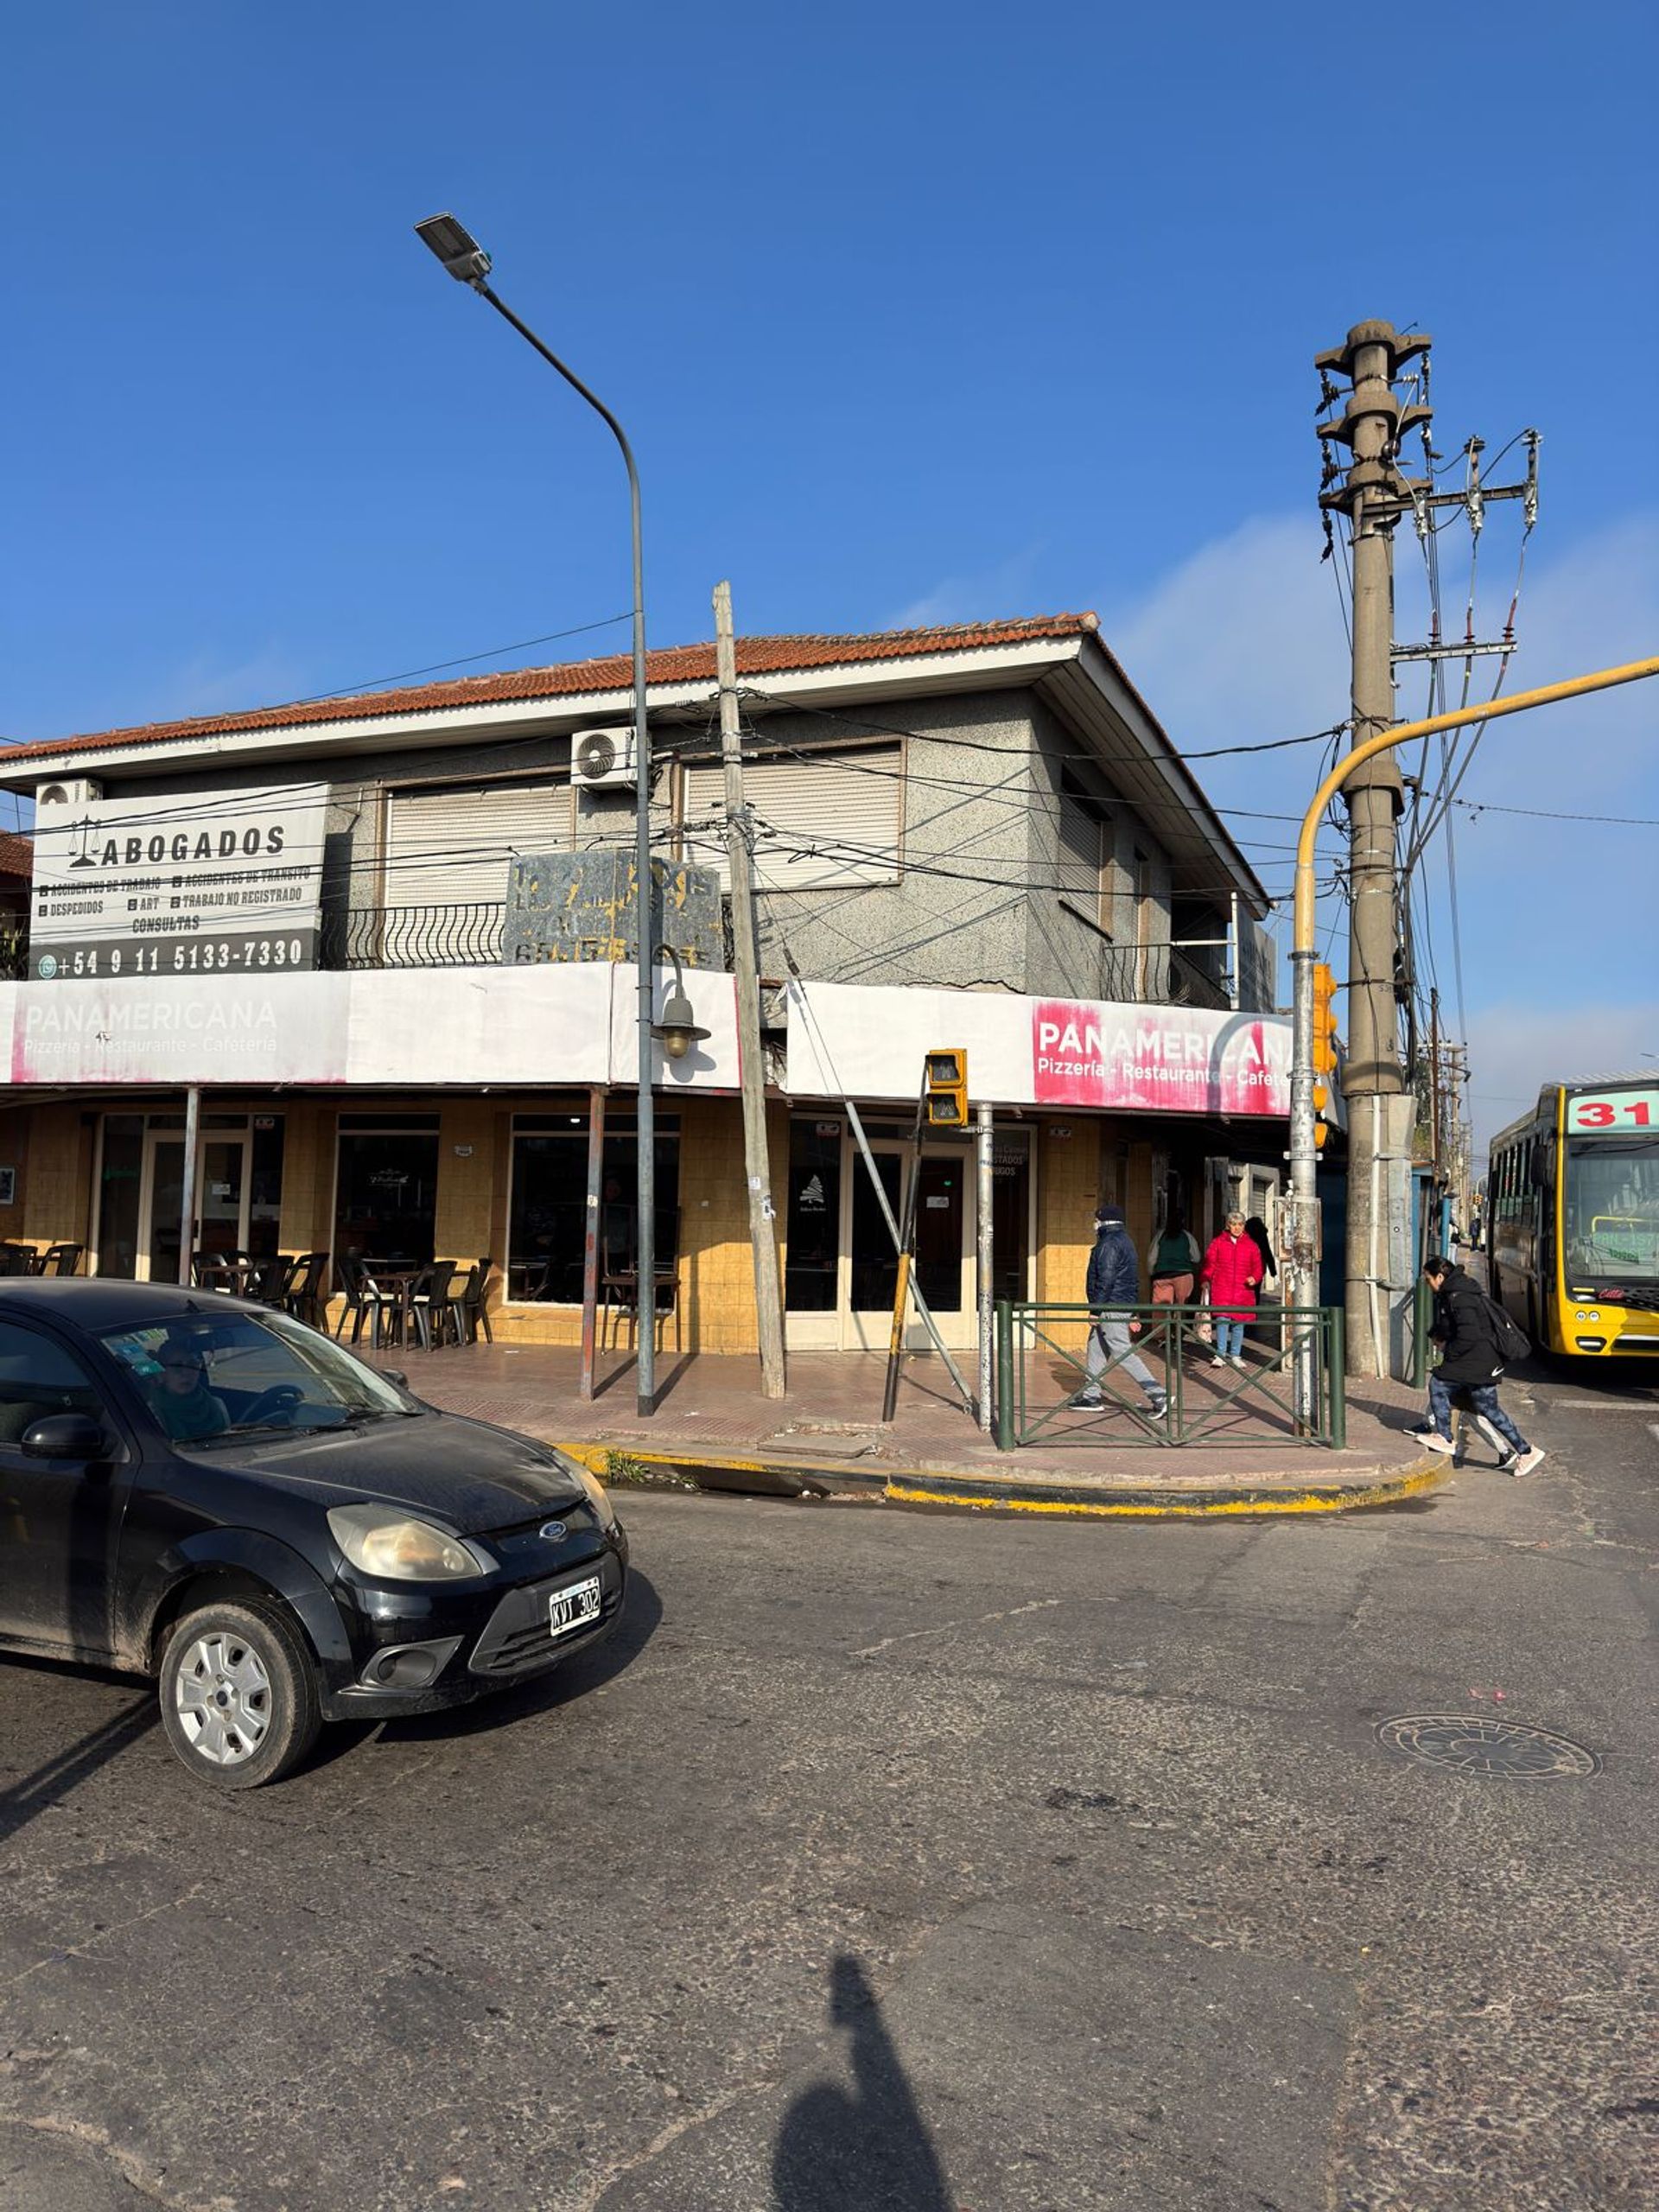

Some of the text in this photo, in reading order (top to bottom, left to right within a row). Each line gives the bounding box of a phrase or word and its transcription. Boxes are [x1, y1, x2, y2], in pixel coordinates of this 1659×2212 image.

[101, 826, 284, 865] ABOGADOS
[51, 880, 105, 896] ACCIDENTES
[106, 880, 119, 893] DE
[185, 871, 243, 887] ACCIDENTES
[246, 871, 258, 883] DE
[50, 900, 104, 916] DESPEDIDOS
[140, 898, 160, 910] ART
[183, 887, 302, 907] TRABAJO NO REGISTRADO
[132, 915, 200, 933] CONSULTAS
[58, 939, 302, 976] +54 9 11 5133-7330
[26, 1001, 276, 1033] PANAMERICANA
[1039, 1022, 1294, 1065] PANAMERICAN
[1038, 1058, 1104, 1077] Pizzería
[1237, 1069, 1292, 1086] Cafete
[1577, 1102, 1649, 1128] 31
[553, 1598, 573, 1628] KVT
[578, 1588, 599, 1616] 302
